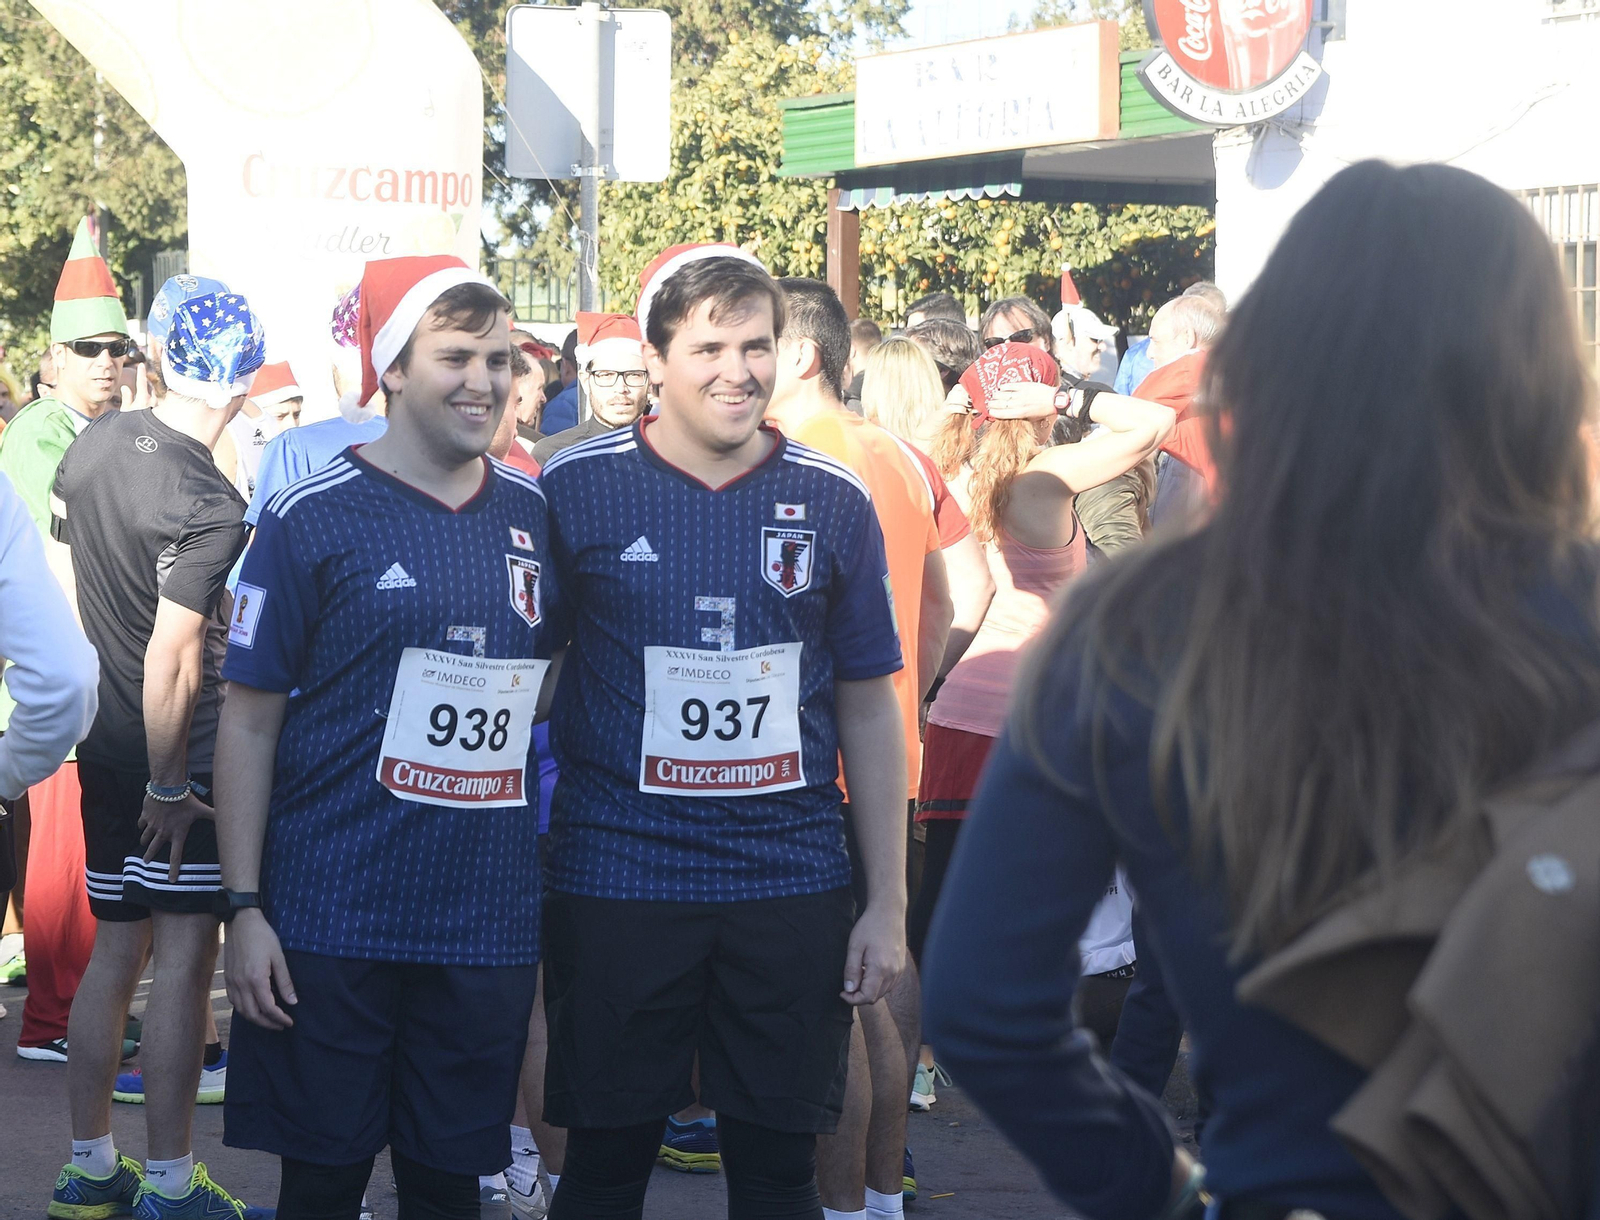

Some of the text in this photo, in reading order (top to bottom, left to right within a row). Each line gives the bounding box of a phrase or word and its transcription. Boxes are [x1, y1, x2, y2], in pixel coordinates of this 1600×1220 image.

[1157, 62, 1316, 119] BAR LA ALEGRIA
[776, 532, 804, 540] JAPAN
[517, 560, 536, 571] JAPAN
[620, 552, 659, 562] adidas
[376, 577, 417, 590] adidas
[423, 652, 456, 666] XXXVI
[457, 659, 473, 668] San
[475, 661, 505, 671] Silvestre
[666, 647, 785, 663] XXXVI San Silvestre Cordobesa
[437, 671, 487, 688] IMDECO
[681, 667, 731, 680] IMDECO
[681, 694, 770, 741] 937
[427, 703, 511, 751] 938
[393, 761, 514, 799] Cruzcampo SIN
[656, 758, 790, 786] Cruzcampo SIN
